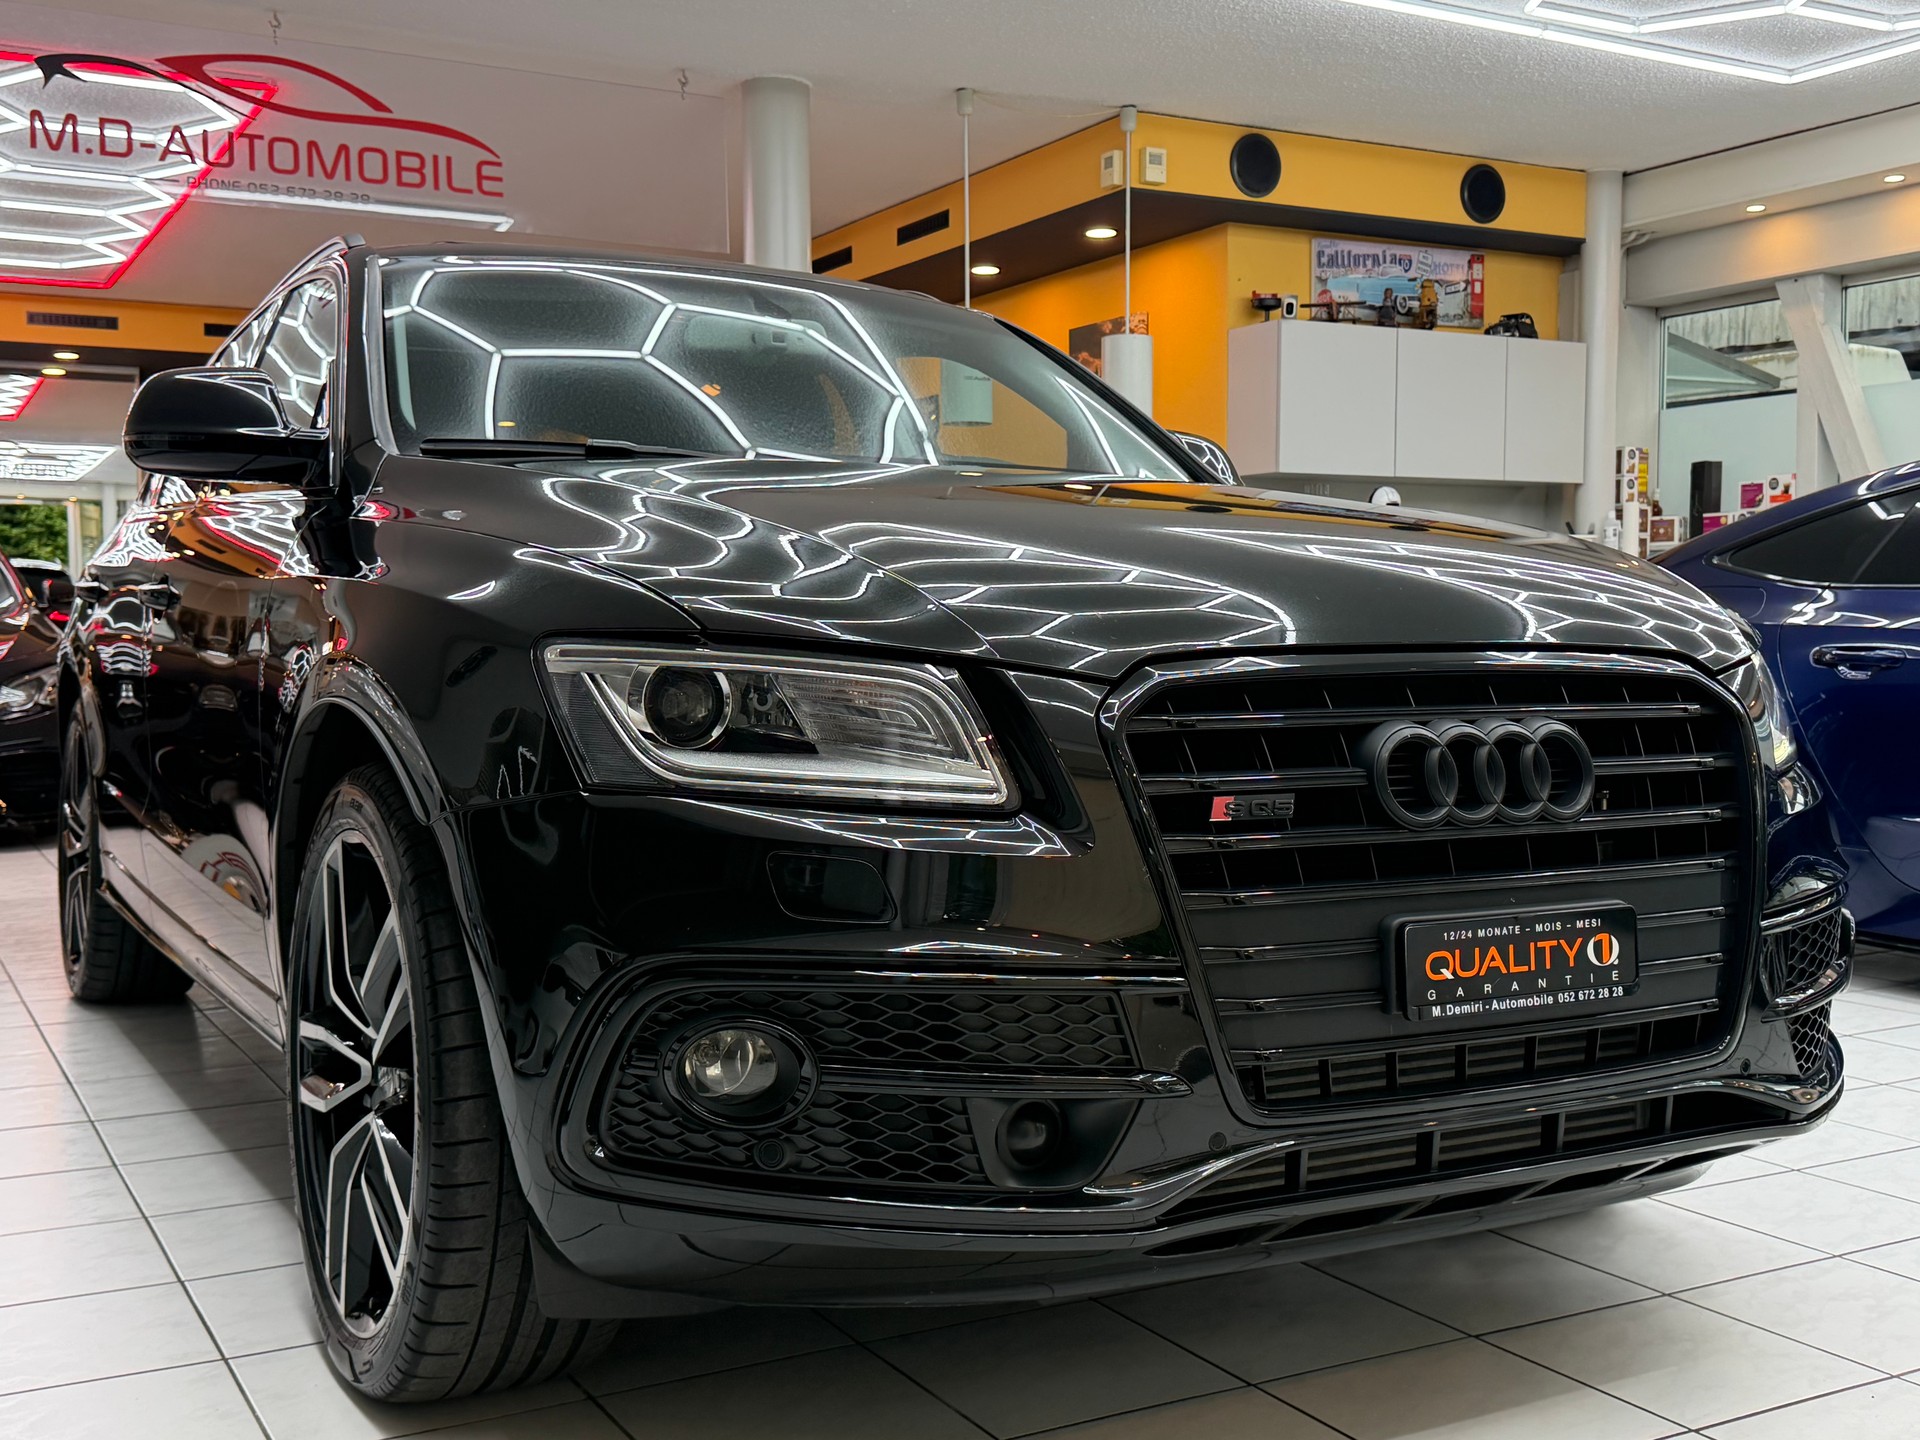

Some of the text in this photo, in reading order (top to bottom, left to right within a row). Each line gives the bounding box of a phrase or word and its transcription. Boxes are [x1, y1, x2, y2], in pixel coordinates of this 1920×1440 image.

[29, 109, 504, 198] M.D-AUTOMOBILE
[186, 176, 242, 191] PHONE
[1316, 249, 1397, 270] California
[1223, 799, 1294, 817] SQ5
[1443, 930, 1473, 941] 12/24
[1477, 925, 1521, 938] MONATE
[1535, 921, 1562, 932] MOIS
[1576, 918, 1601, 929] MESI
[1425, 937, 1583, 981] QUALITY
[1427, 970, 1619, 1001] GARANTIE
[1432, 1000, 1483, 1018] M.Demiri
[1492, 993, 1554, 1011] Automobile
[1558, 992, 1576, 1003] 052
[1578, 989, 1596, 1001] 672
[1598, 988, 1610, 998] 28
[1612, 985, 1624, 997] 28
